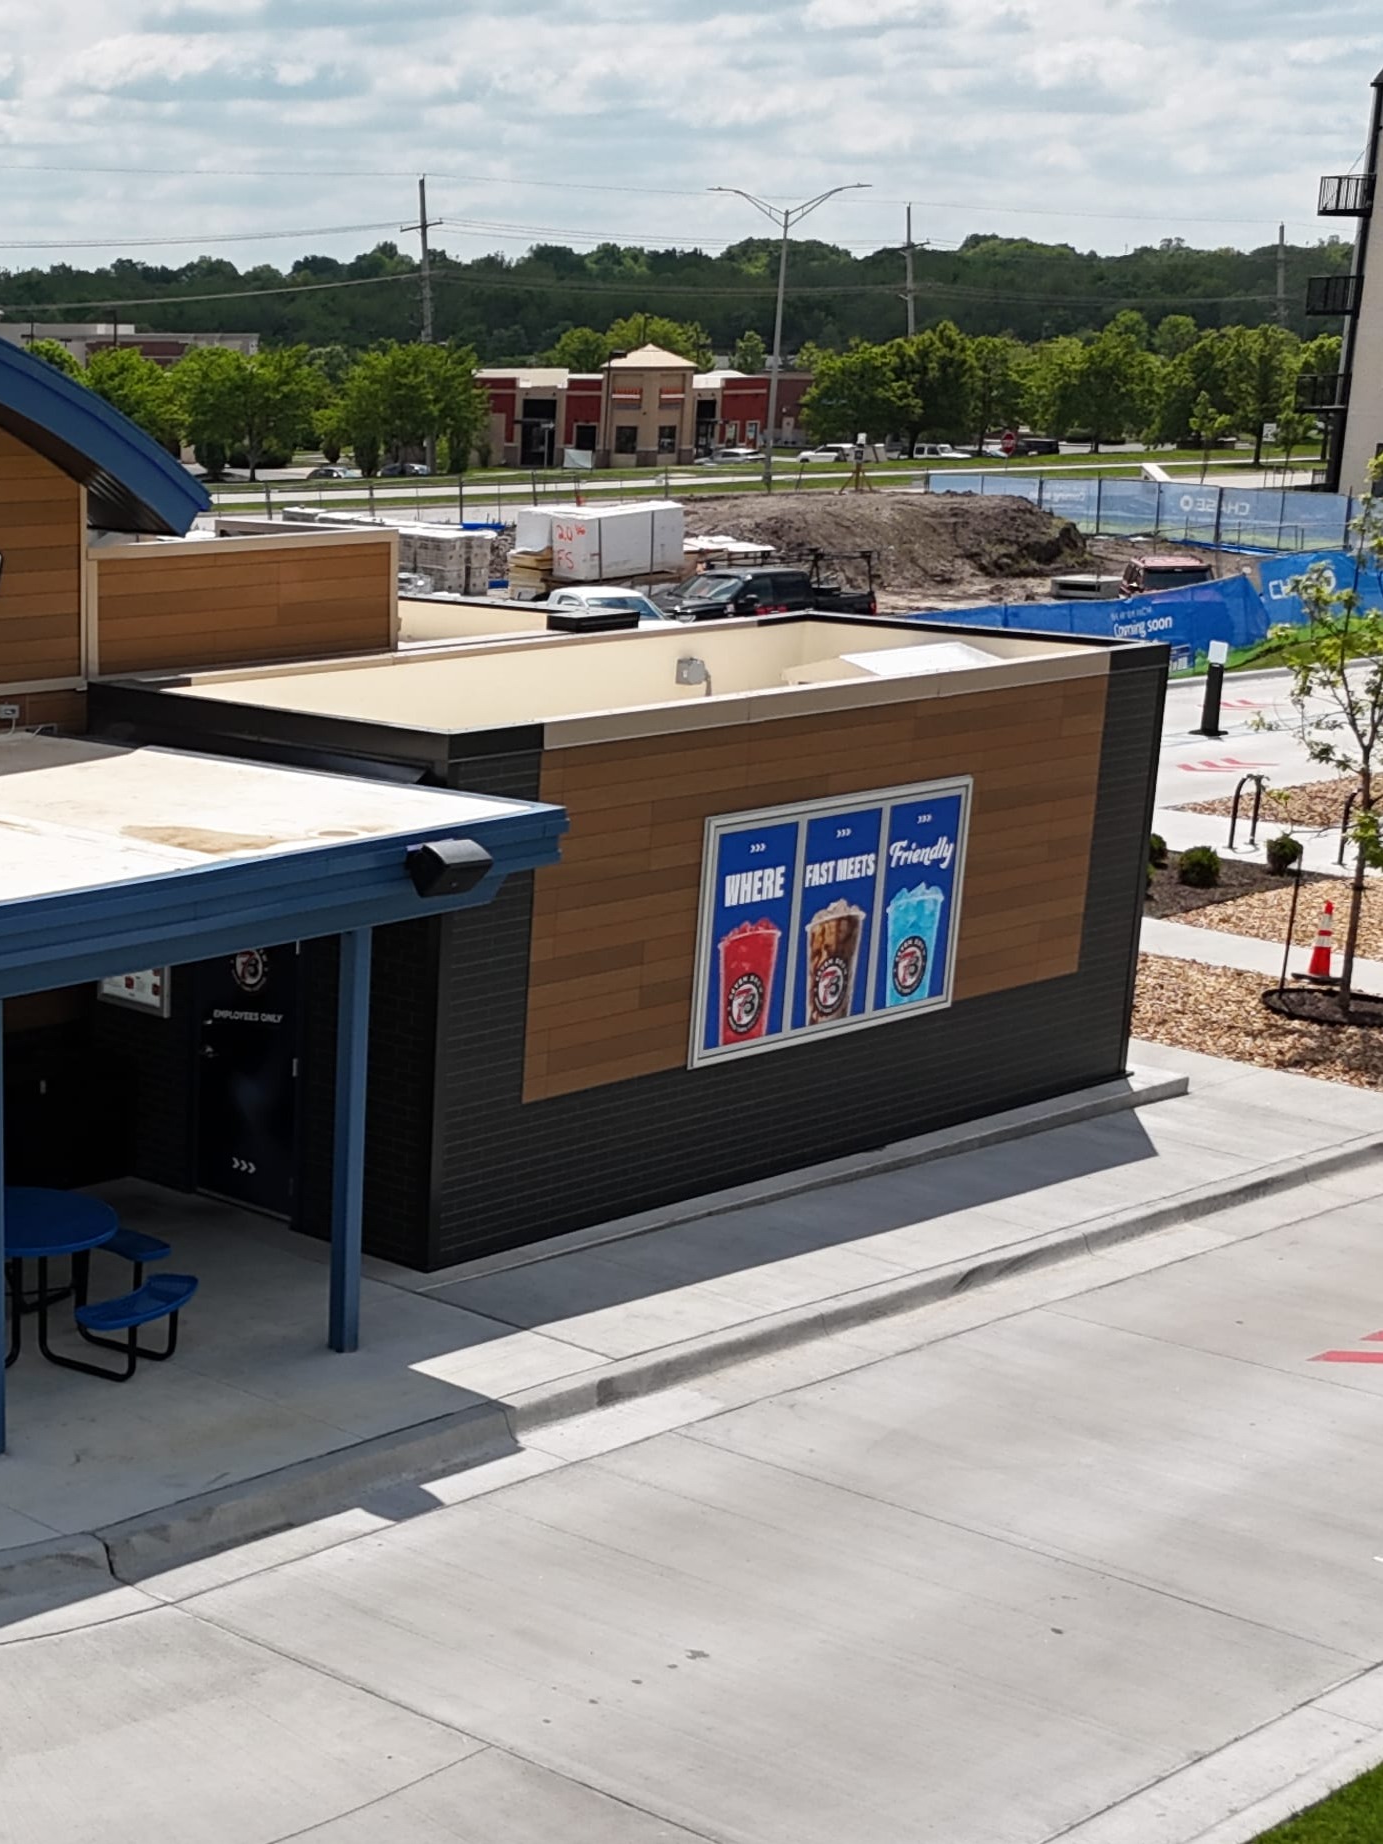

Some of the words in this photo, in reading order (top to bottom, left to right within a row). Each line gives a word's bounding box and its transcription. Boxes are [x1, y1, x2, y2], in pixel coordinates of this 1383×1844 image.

[1113, 621, 1147, 638] Coming
[1147, 616, 1173, 633] soon
[889, 836, 955, 869] Friendly
[724, 865, 786, 907] WHERE
[804, 859, 835, 888] FAST
[835, 852, 876, 882] MEETS
[213, 1009, 259, 1022] EMPLOYEES
[260, 1012, 283, 1023] ONLY
